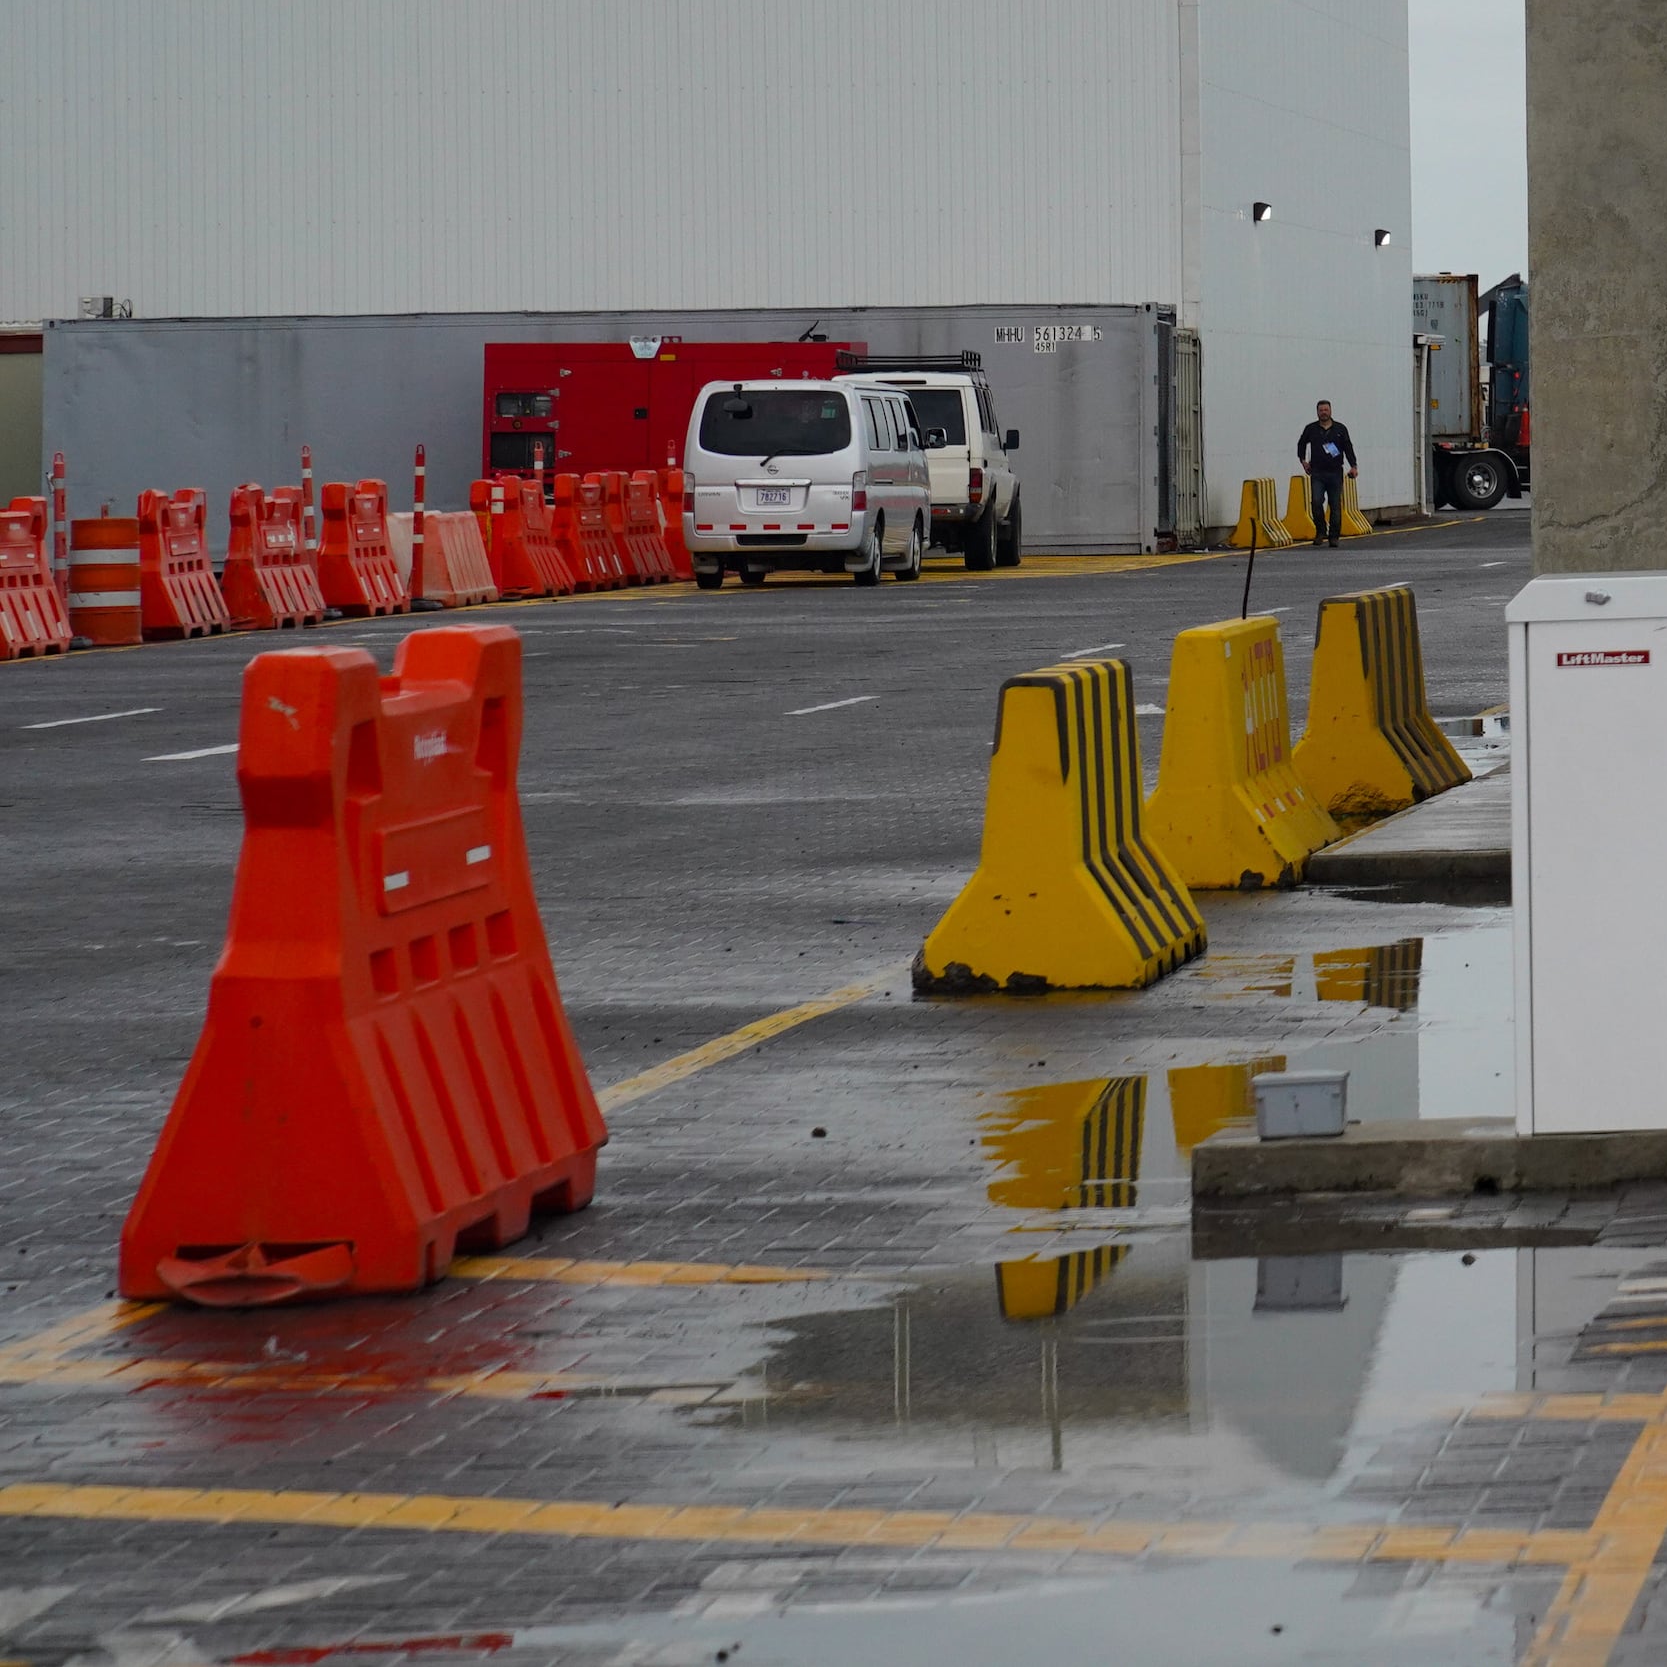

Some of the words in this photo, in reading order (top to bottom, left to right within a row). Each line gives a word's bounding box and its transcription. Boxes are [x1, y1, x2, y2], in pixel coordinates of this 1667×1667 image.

[996, 327, 1023, 342] MHHU
[1035, 325, 1082, 341] 561324
[1035, 342, 1055, 352] 45R1
[1562, 652, 1645, 665] LiftMaster
